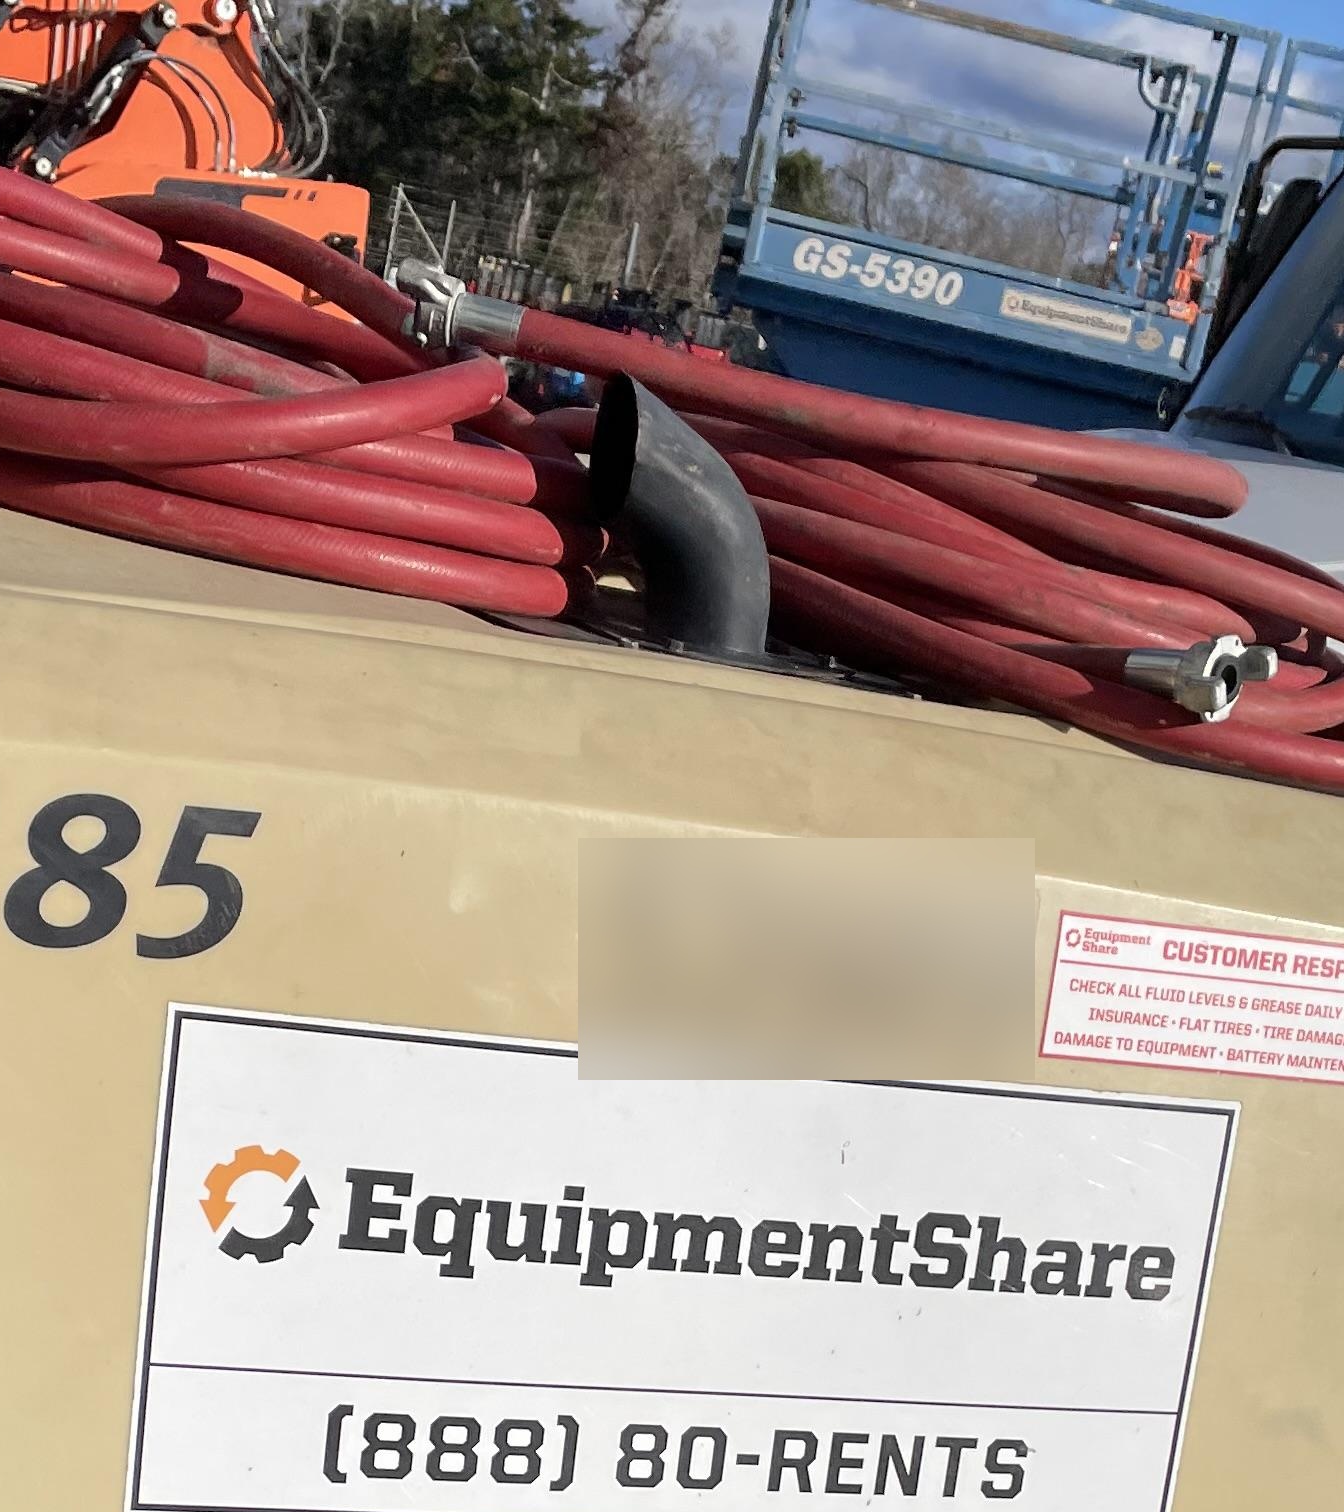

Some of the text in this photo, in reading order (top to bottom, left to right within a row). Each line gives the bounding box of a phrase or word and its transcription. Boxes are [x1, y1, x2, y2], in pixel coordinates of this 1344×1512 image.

[792, 237, 965, 306] GS-5390
[1082, 941, 1119, 955] Share
[1083, 928, 1151, 946] Equipment
[1162, 939, 1288, 973] CUSTOMER
[1069, 978, 1115, 996] CHECK
[1118, 983, 1142, 999] ALL
[1145, 986, 1186, 1003] FLUID
[1188, 989, 1236, 1008] LEVELS
[1239, 996, 1249, 1010] &
[1251, 997, 1303, 1016] GREASE
[1304, 1003, 1343, 1020] DAILY
[1088, 1007, 1168, 1028] INSURANCE
[1178, 1016, 1212, 1032] FLAT
[1213, 1019, 1252, 1037] TIRES
[1263, 1025, 1293, 1041] TIRE
[1053, 1031, 1113, 1050] DAMAGE
[1116, 1037, 1133, 1052] TO
[1136, 1040, 1217, 1059] EQUIPMENT
[1226, 1048, 1285, 1067] BATTERY
[338, 1166, 1176, 1301] EquipmentShare
[322, 1403, 1033, 1500] (888) 80-RENTS
